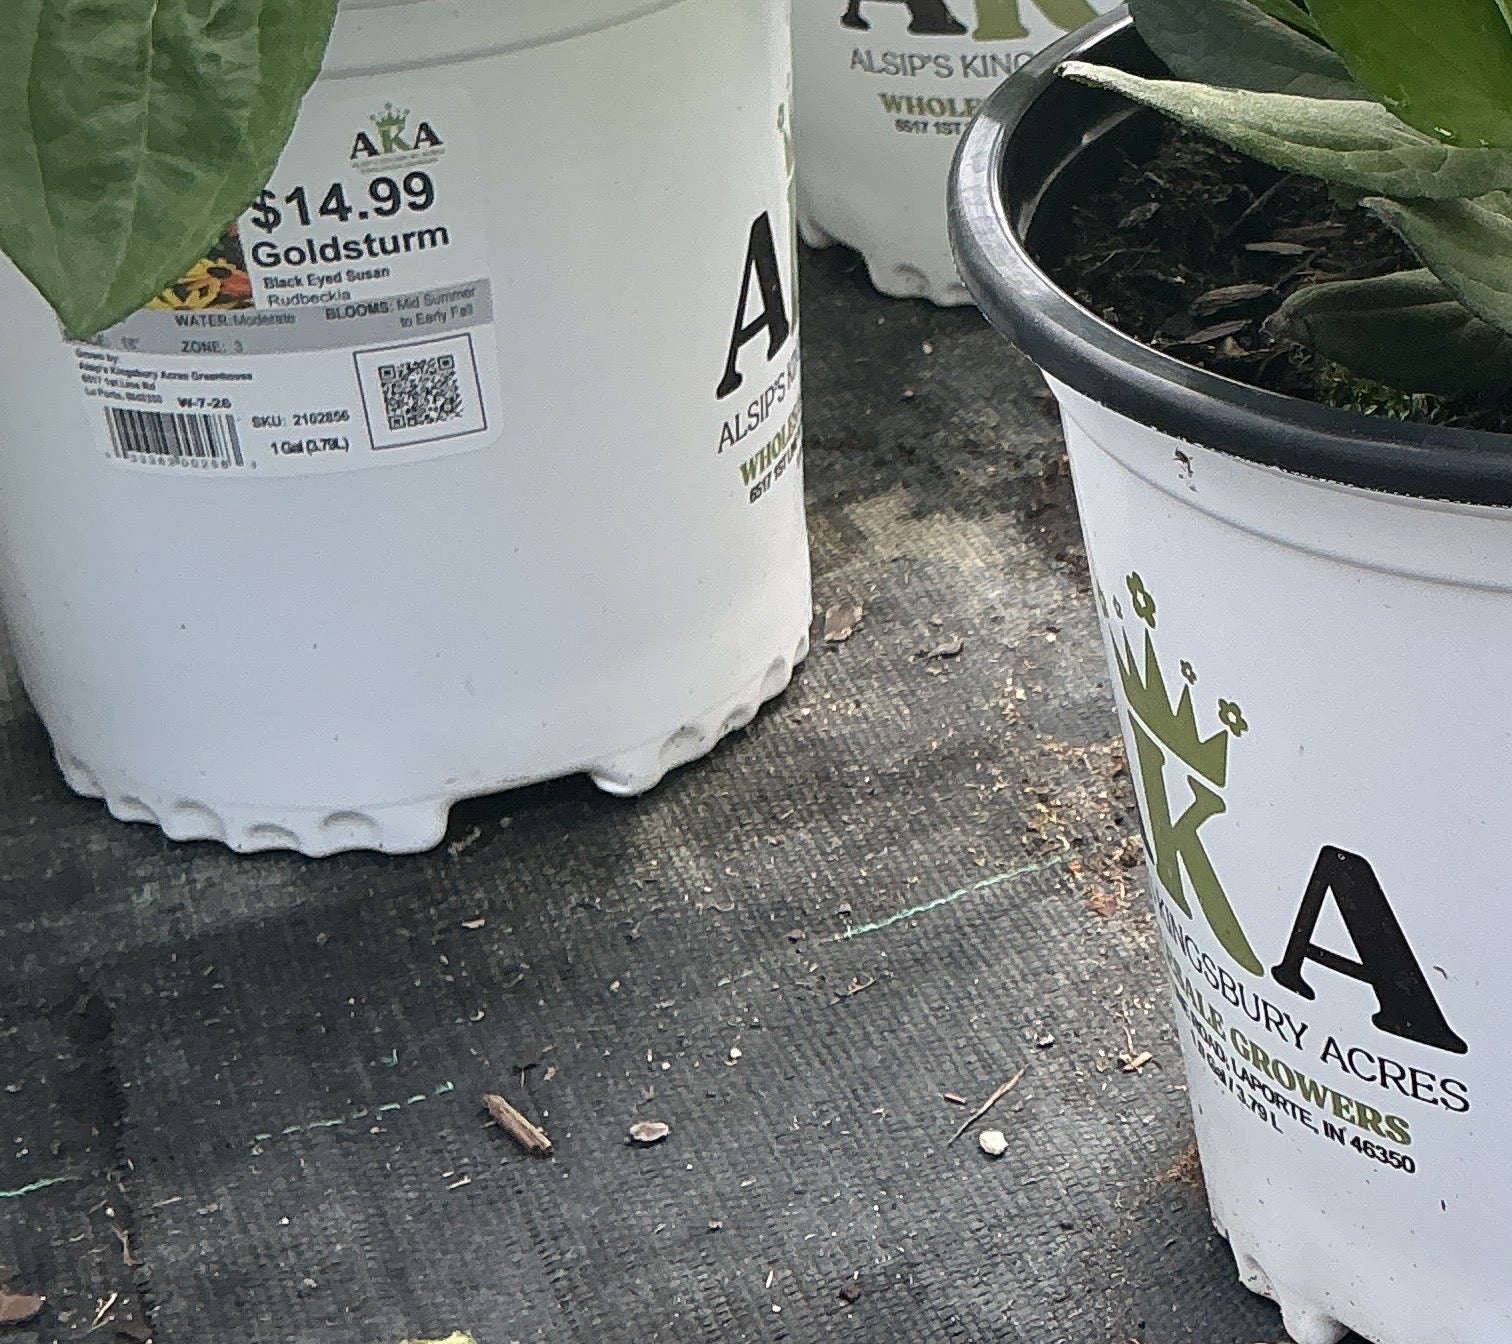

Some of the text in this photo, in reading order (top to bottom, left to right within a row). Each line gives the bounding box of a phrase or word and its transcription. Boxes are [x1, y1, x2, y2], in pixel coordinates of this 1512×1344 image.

[850, 48, 955, 79] ALSIP'S
[349, 121, 444, 160] AKA
[251, 170, 436, 234] $14.99
[251, 226, 450, 269] Goldsturm
[263, 275, 304, 290] Black
[346, 266, 390, 281] Susan
[267, 289, 352, 308] Rudbeckia
[717, 371, 785, 454] ALSIP'S
[270, 441, 278, 455] 1
[1229, 1027, 1412, 1146] GROWERS
[1320, 1035, 1471, 1113] ACRES
[1231, 1057, 1319, 1135] LAPORTE,
[1323, 1119, 1347, 1146] IN
[1350, 1135, 1416, 1174] 46350
[1270, 1110, 1284, 1135] L
